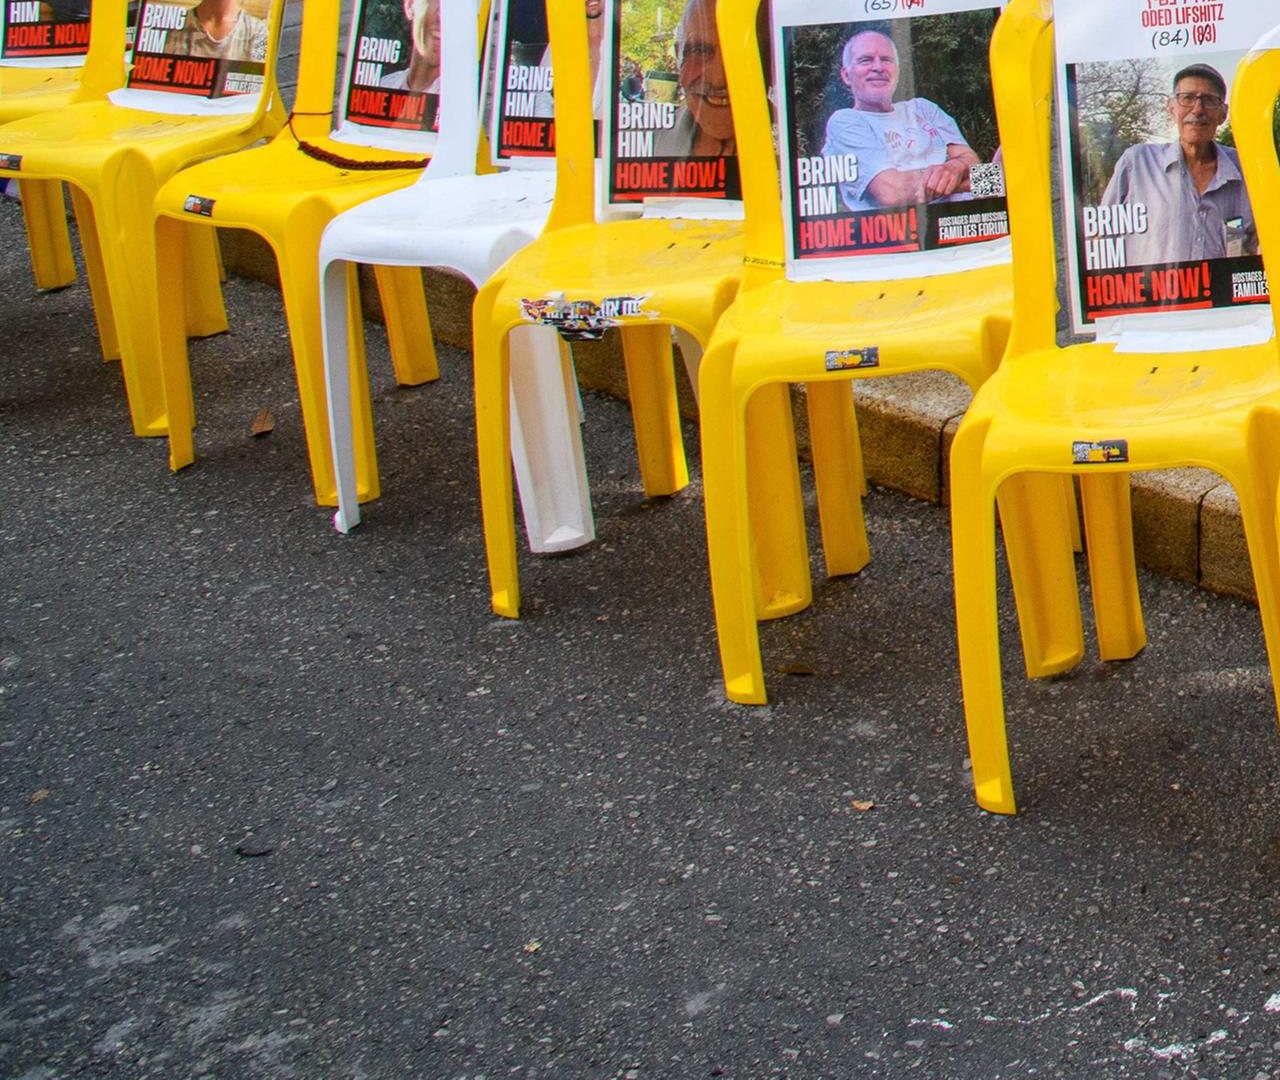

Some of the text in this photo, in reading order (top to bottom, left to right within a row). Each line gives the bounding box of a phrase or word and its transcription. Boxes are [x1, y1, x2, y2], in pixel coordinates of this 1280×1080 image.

[11, 2, 41, 23] HIM
[1141, 4, 1225, 28] ODED LIFSHITZ
[1151, 24, 1217, 50] (84) (83)
